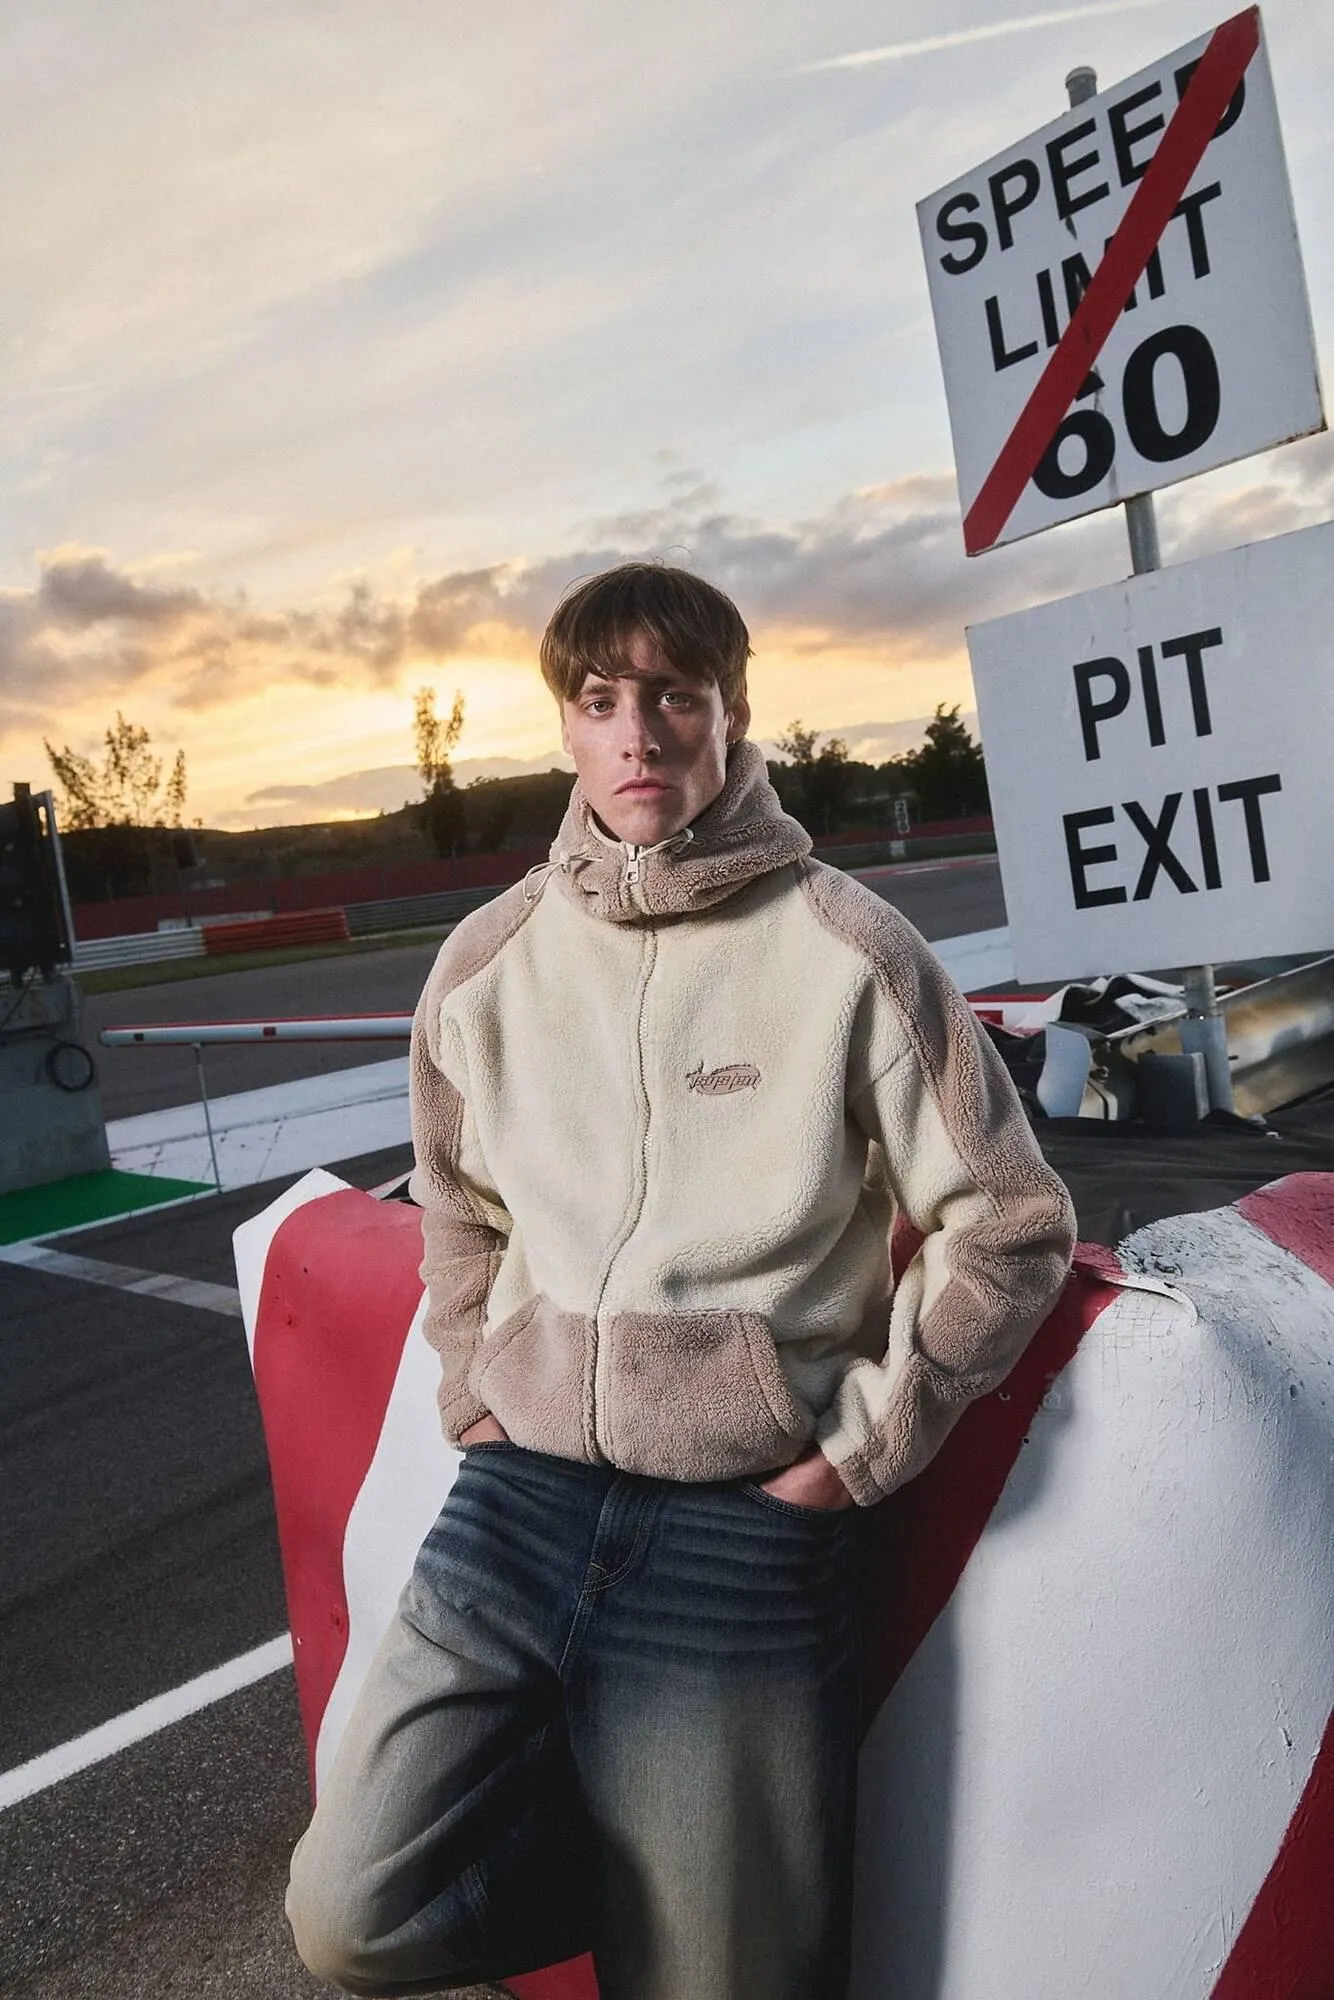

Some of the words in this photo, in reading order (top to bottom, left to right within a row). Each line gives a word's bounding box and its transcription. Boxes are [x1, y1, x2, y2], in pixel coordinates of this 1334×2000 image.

[1032, 324, 1220, 499] 60
[1073, 627, 1223, 761] PIT
[1063, 774, 1282, 909] EXIT
